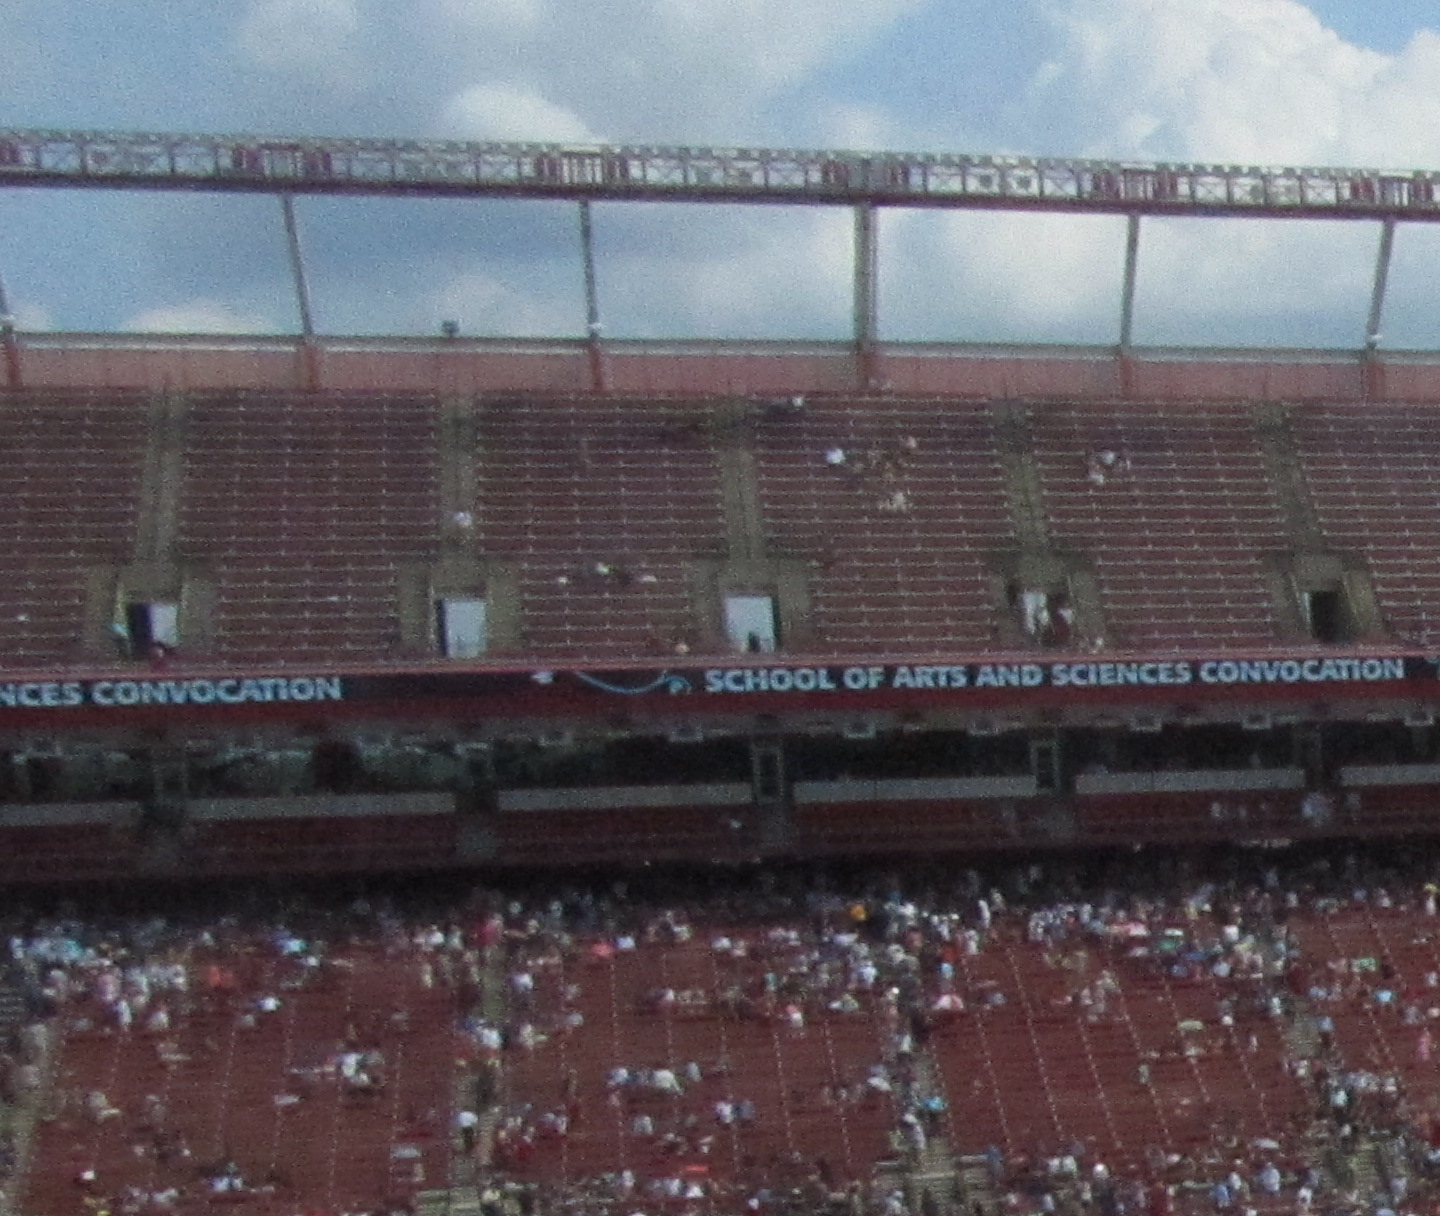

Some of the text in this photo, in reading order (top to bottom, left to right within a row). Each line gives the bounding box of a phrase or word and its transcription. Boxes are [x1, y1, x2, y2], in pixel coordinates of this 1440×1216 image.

[707, 658, 1404, 690] SCHOOL OF ARTS AND SCIENCES CONVOCATION
[93, 677, 341, 703] CONVOCATION
